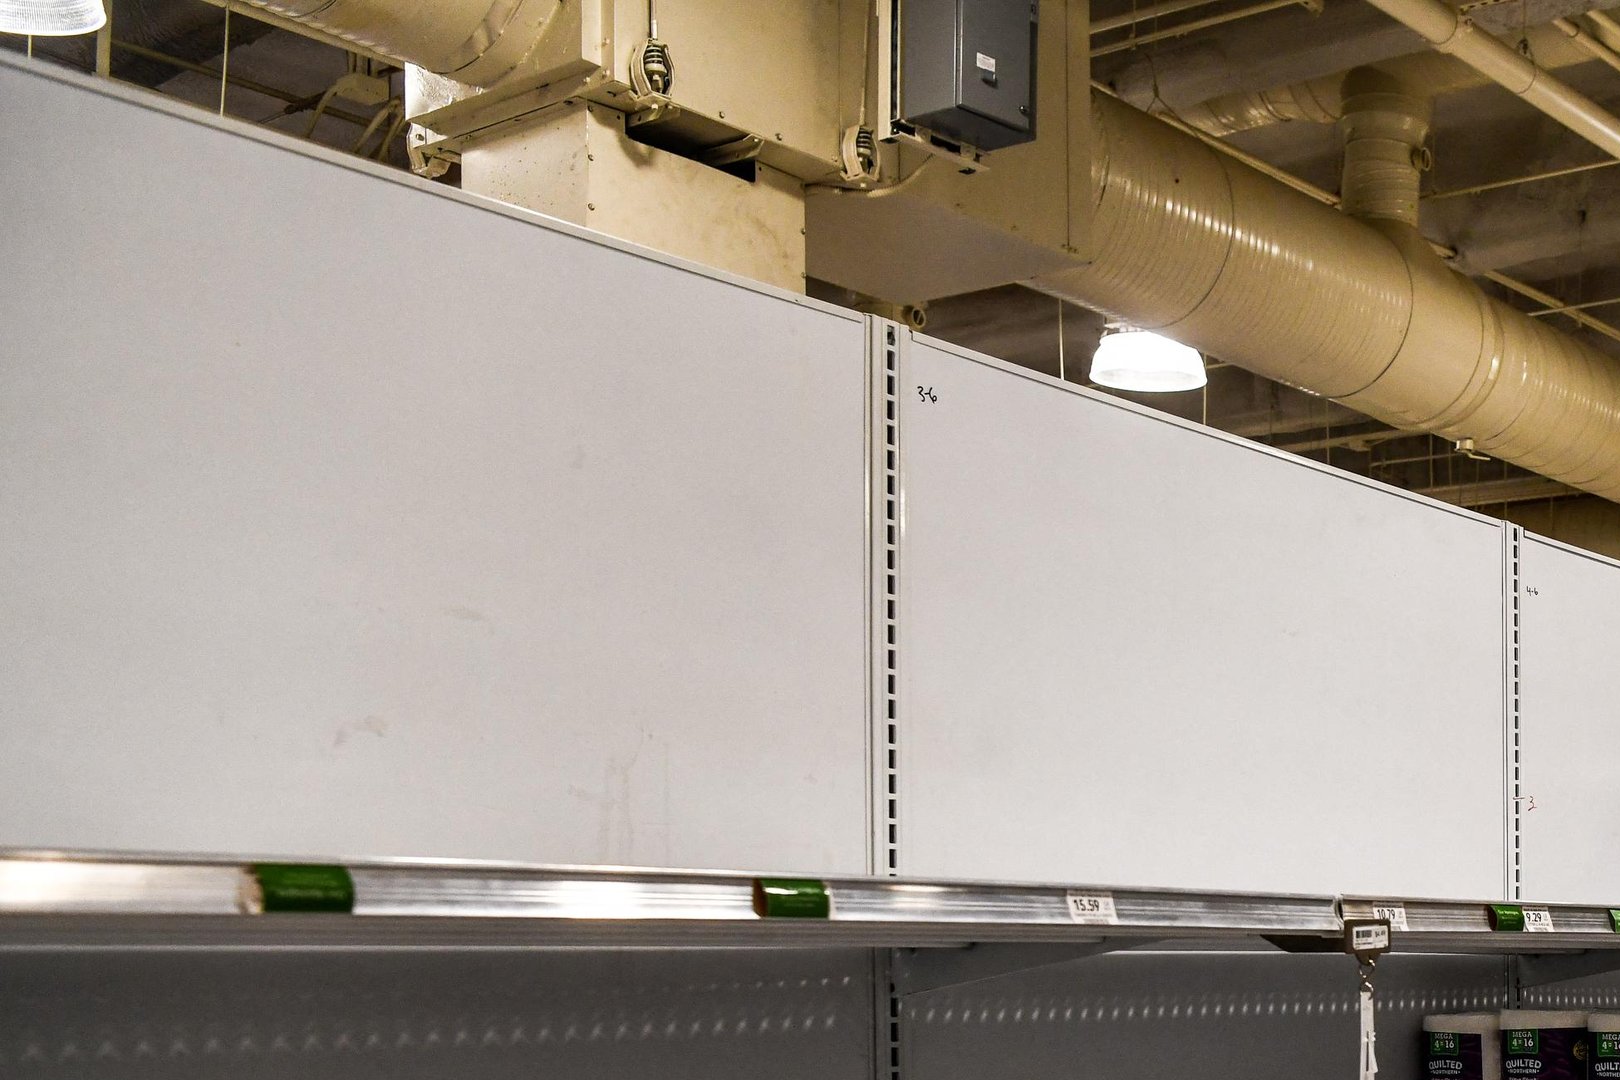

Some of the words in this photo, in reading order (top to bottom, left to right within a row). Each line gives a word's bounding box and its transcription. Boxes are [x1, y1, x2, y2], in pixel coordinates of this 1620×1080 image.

[1073, 899, 1100, 911] 15.59
[1526, 912, 1542, 922] 9.29
[1428, 1060, 1463, 1070] QUILTED
[1505, 1059, 1542, 1069] QUILTED
